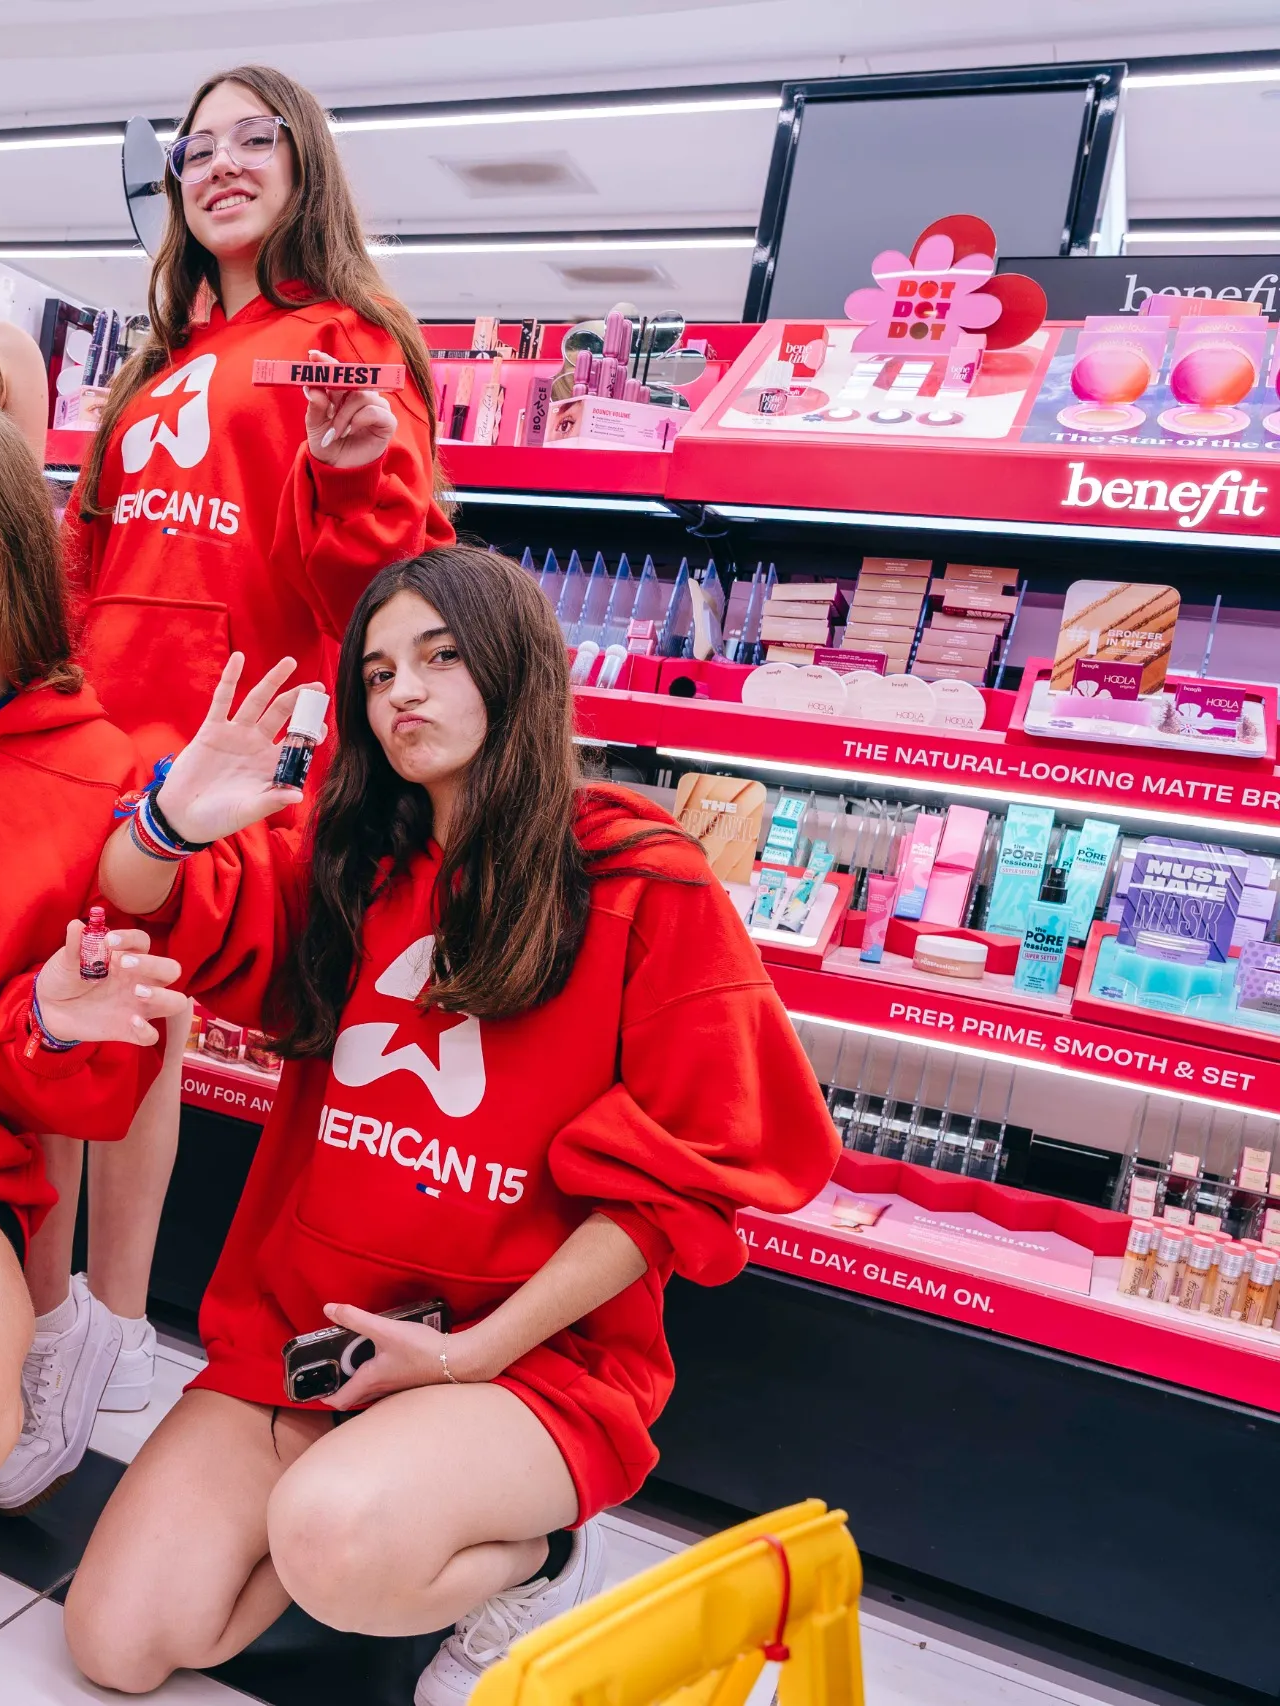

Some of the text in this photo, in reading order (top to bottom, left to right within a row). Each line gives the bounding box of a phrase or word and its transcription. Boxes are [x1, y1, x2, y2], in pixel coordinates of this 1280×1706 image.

[897, 279, 956, 299] DOT
[892, 301, 951, 319] DOT
[887, 321, 946, 340] DOT
[786, 342, 812, 354] bene
[789, 353, 809, 364] tint
[290, 364, 330, 383] FAN
[332, 367, 381, 385] FEST
[592, 408, 631, 420] BOUNCY VOLUME
[1049, 432, 1105, 444] The
[1108, 434, 1173, 446] Star
[1176, 438, 1215, 448] of
[1212, 439, 1259, 449] the
[1060, 462, 1268, 528] benefit
[208, 497, 241, 535] 15
[1106, 629, 1163, 641] BRONZER
[1106, 639, 1118, 647] IN
[1120, 640, 1142, 648] THE
[1103, 674, 1136, 686] HOOLA
[1206, 698, 1239, 710] HOOLA
[842, 740, 888, 761] THE
[894, 746, 1134, 791] NATURAL-LOOKING
[1141, 775, 1234, 804] MATTE
[700, 799, 738, 814] THE
[1002, 848, 1043, 862] PORE
[1078, 849, 1107, 862] PORE
[1146, 859, 1232, 885] MUST
[1143, 875, 1228, 901] HAVE
[1133, 889, 1225, 941] MASK
[1026, 930, 1064, 946] PORE
[890, 1003, 1256, 1091] PREP, PRIME, SMOOTH & SET
[180, 1078, 211, 1097] OW
[214, 1086, 247, 1106] FOR
[318, 1104, 528, 1205] ERICAN 15
[764, 1236, 804, 1260] ALL
[810, 1248, 857, 1275] DAY.
[863, 1263, 947, 1300] GLEAM
[953, 1288, 995, 1314] ON.
